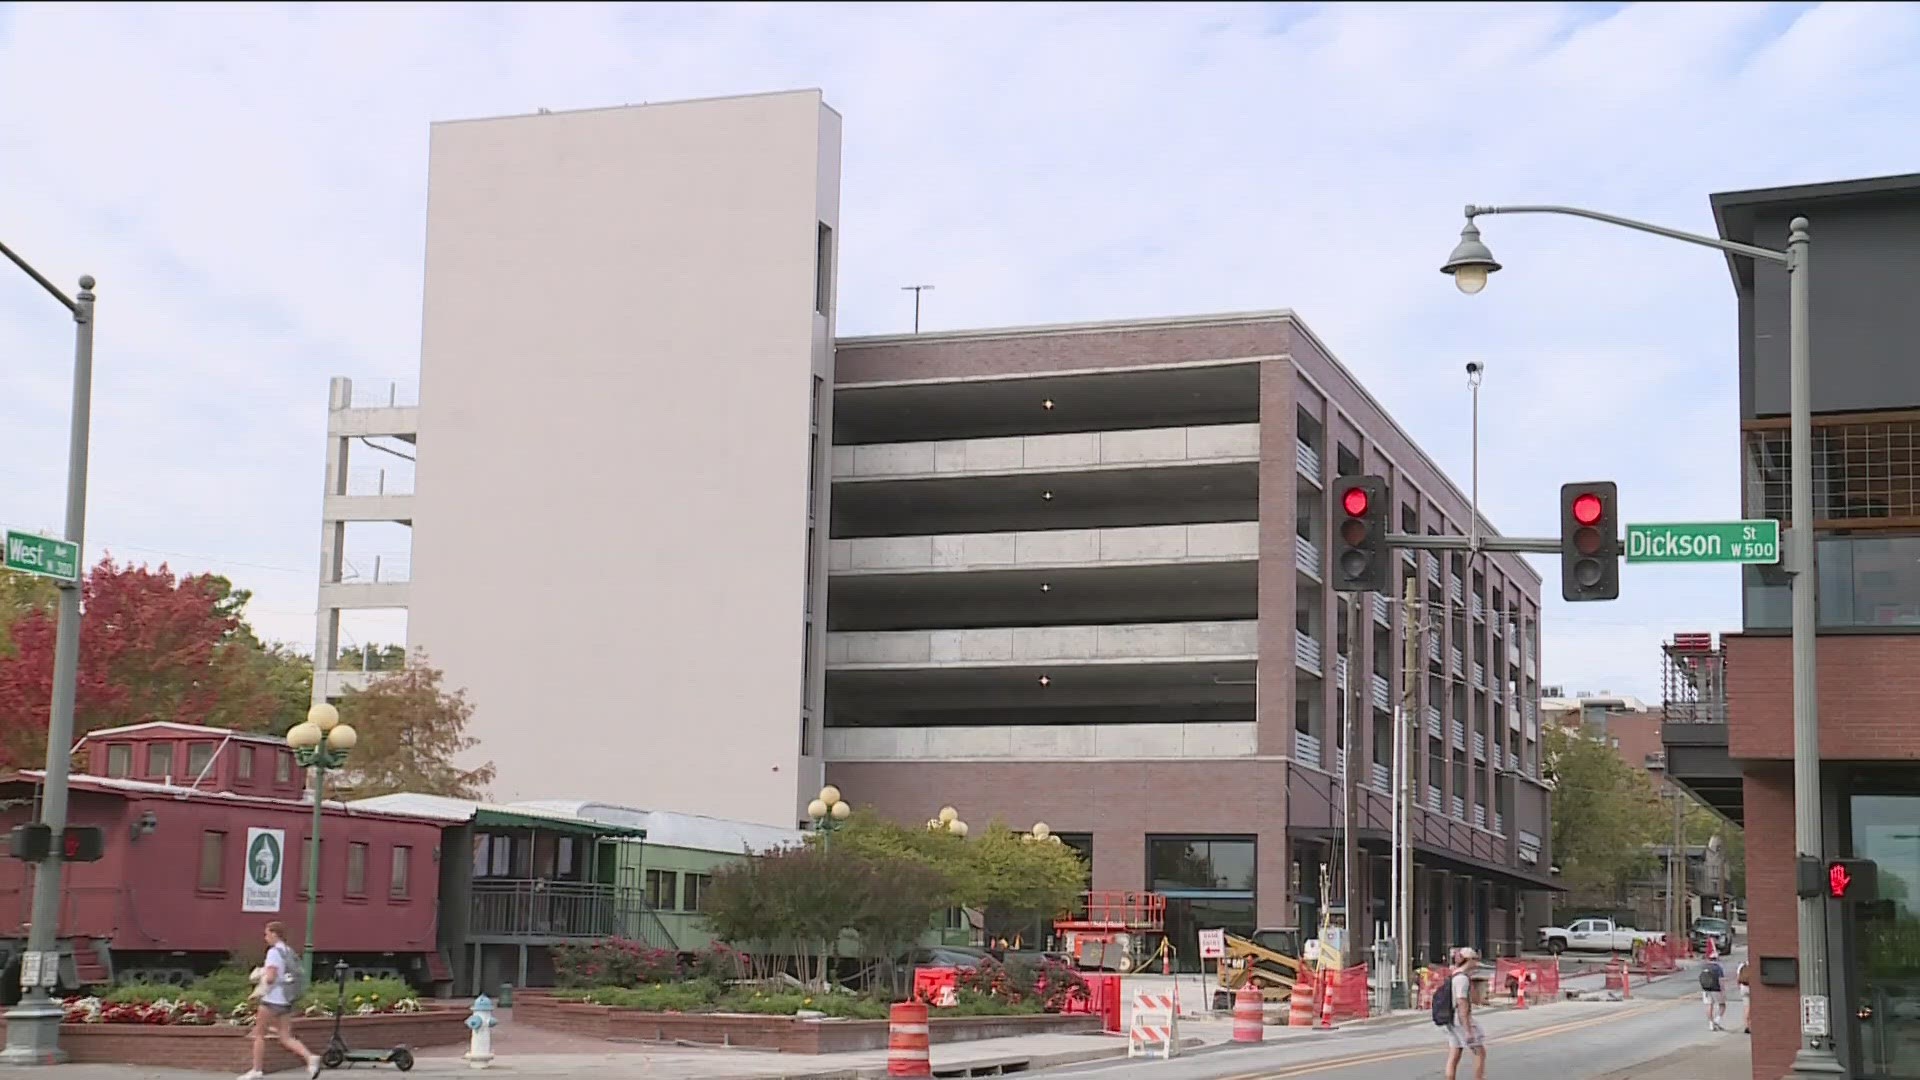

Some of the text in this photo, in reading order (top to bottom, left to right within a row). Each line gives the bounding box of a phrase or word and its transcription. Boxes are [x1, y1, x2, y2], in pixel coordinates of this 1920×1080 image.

[9, 537, 44, 566] West
[1630, 527, 1756, 557] Dickson St
[1731, 543, 1773, 557] W 500
